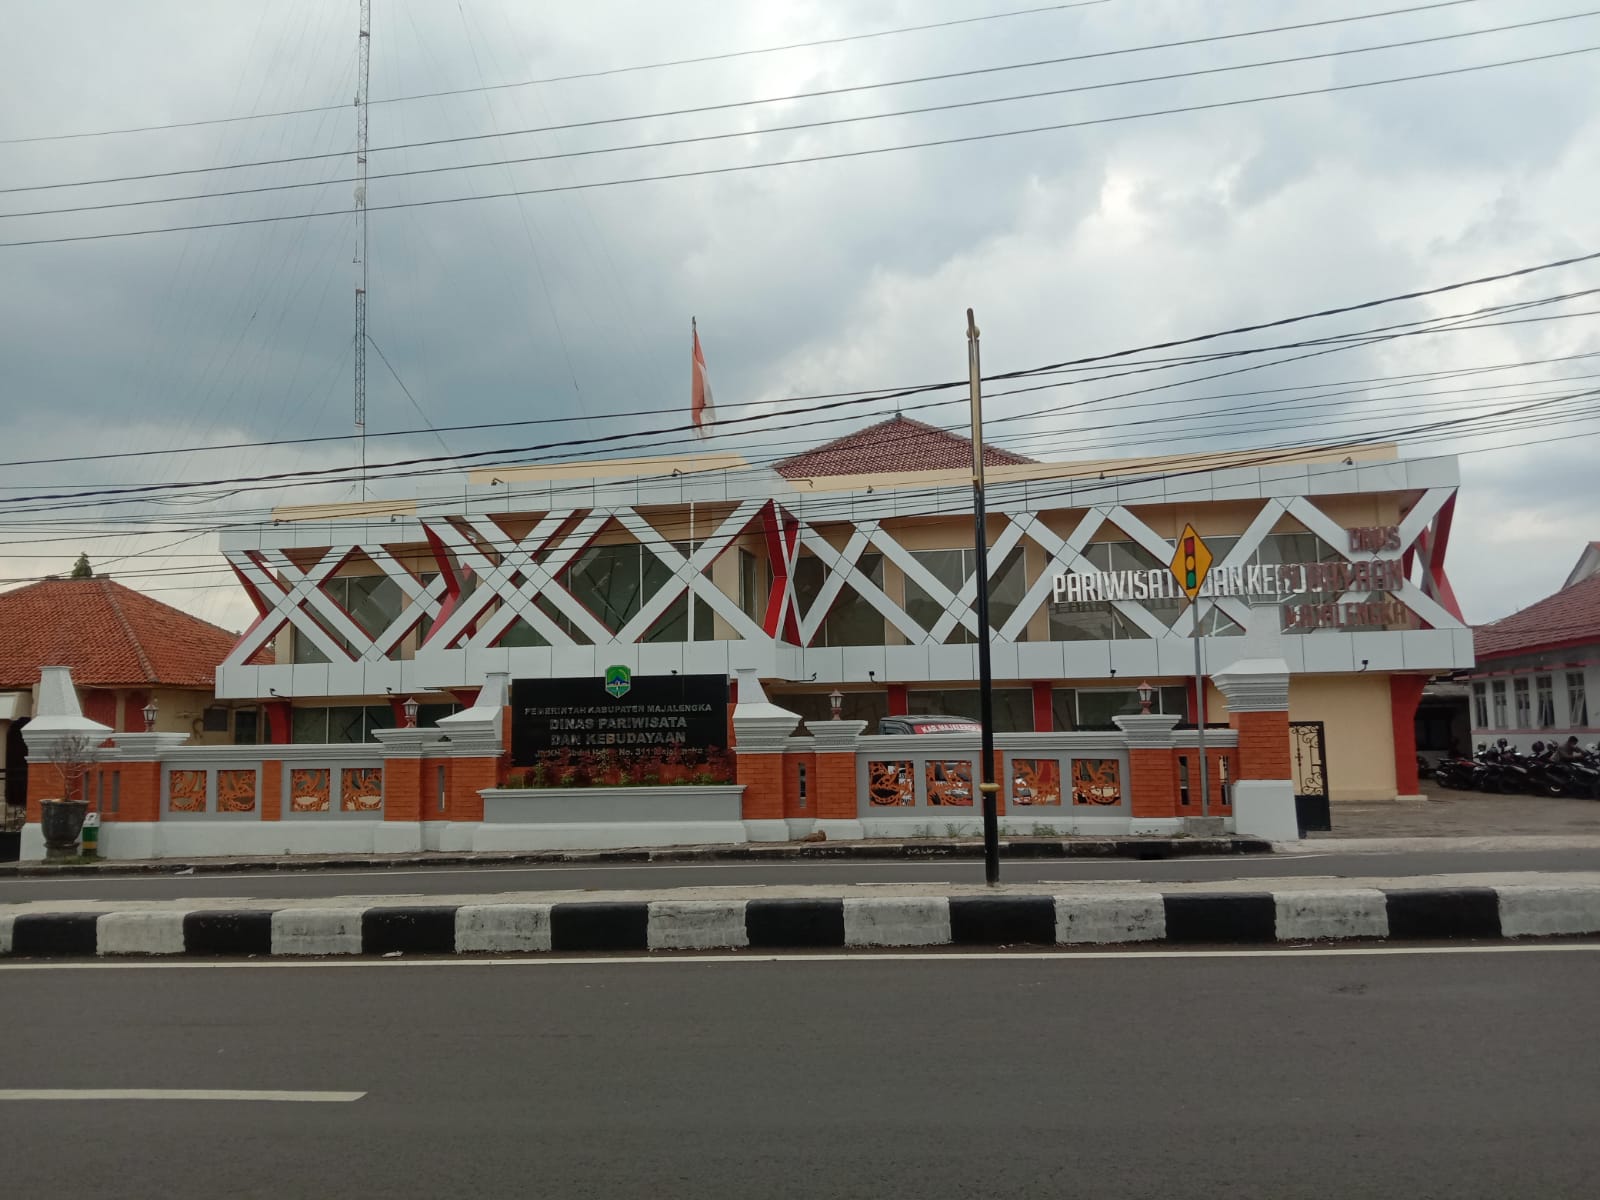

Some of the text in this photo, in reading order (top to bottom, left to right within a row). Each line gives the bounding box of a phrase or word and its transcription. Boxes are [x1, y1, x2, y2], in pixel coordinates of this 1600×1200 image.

[1053, 567, 1187, 603] PARIWISAT
[524, 703, 712, 716] PEMERINTAH KABUPATEN MAJALENGKA
[549, 716, 688, 730] DINAS PARIWISATA
[550, 732, 686, 746] DAN KEBUDAYAAN
